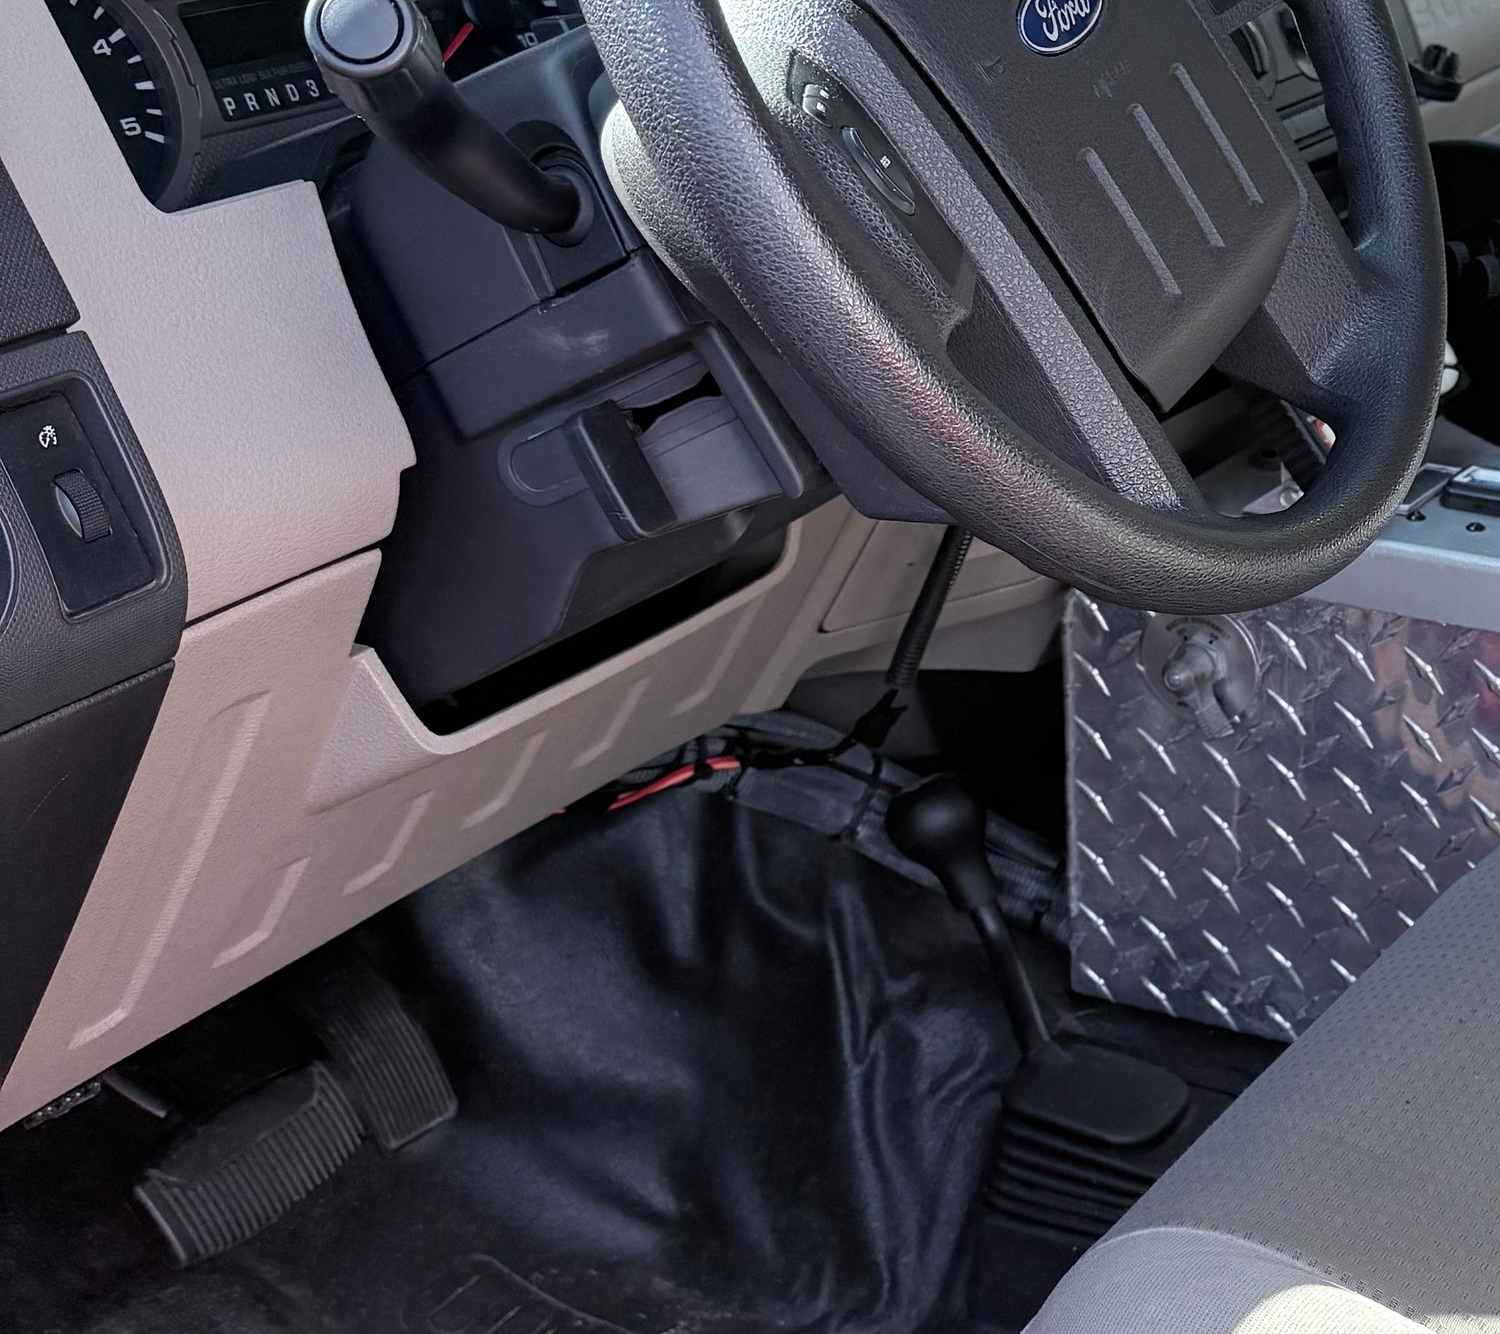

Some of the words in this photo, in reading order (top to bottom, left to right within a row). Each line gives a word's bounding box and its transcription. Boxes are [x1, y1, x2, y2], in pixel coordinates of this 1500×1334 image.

[92, 38, 112, 56] 4
[222, 97, 236, 116] P
[243, 92, 260, 111] R
[264, 88, 281, 106] N
[284, 83, 300, 101] D
[305, 79, 320, 97] 3
[119, 116, 142, 136] 5
